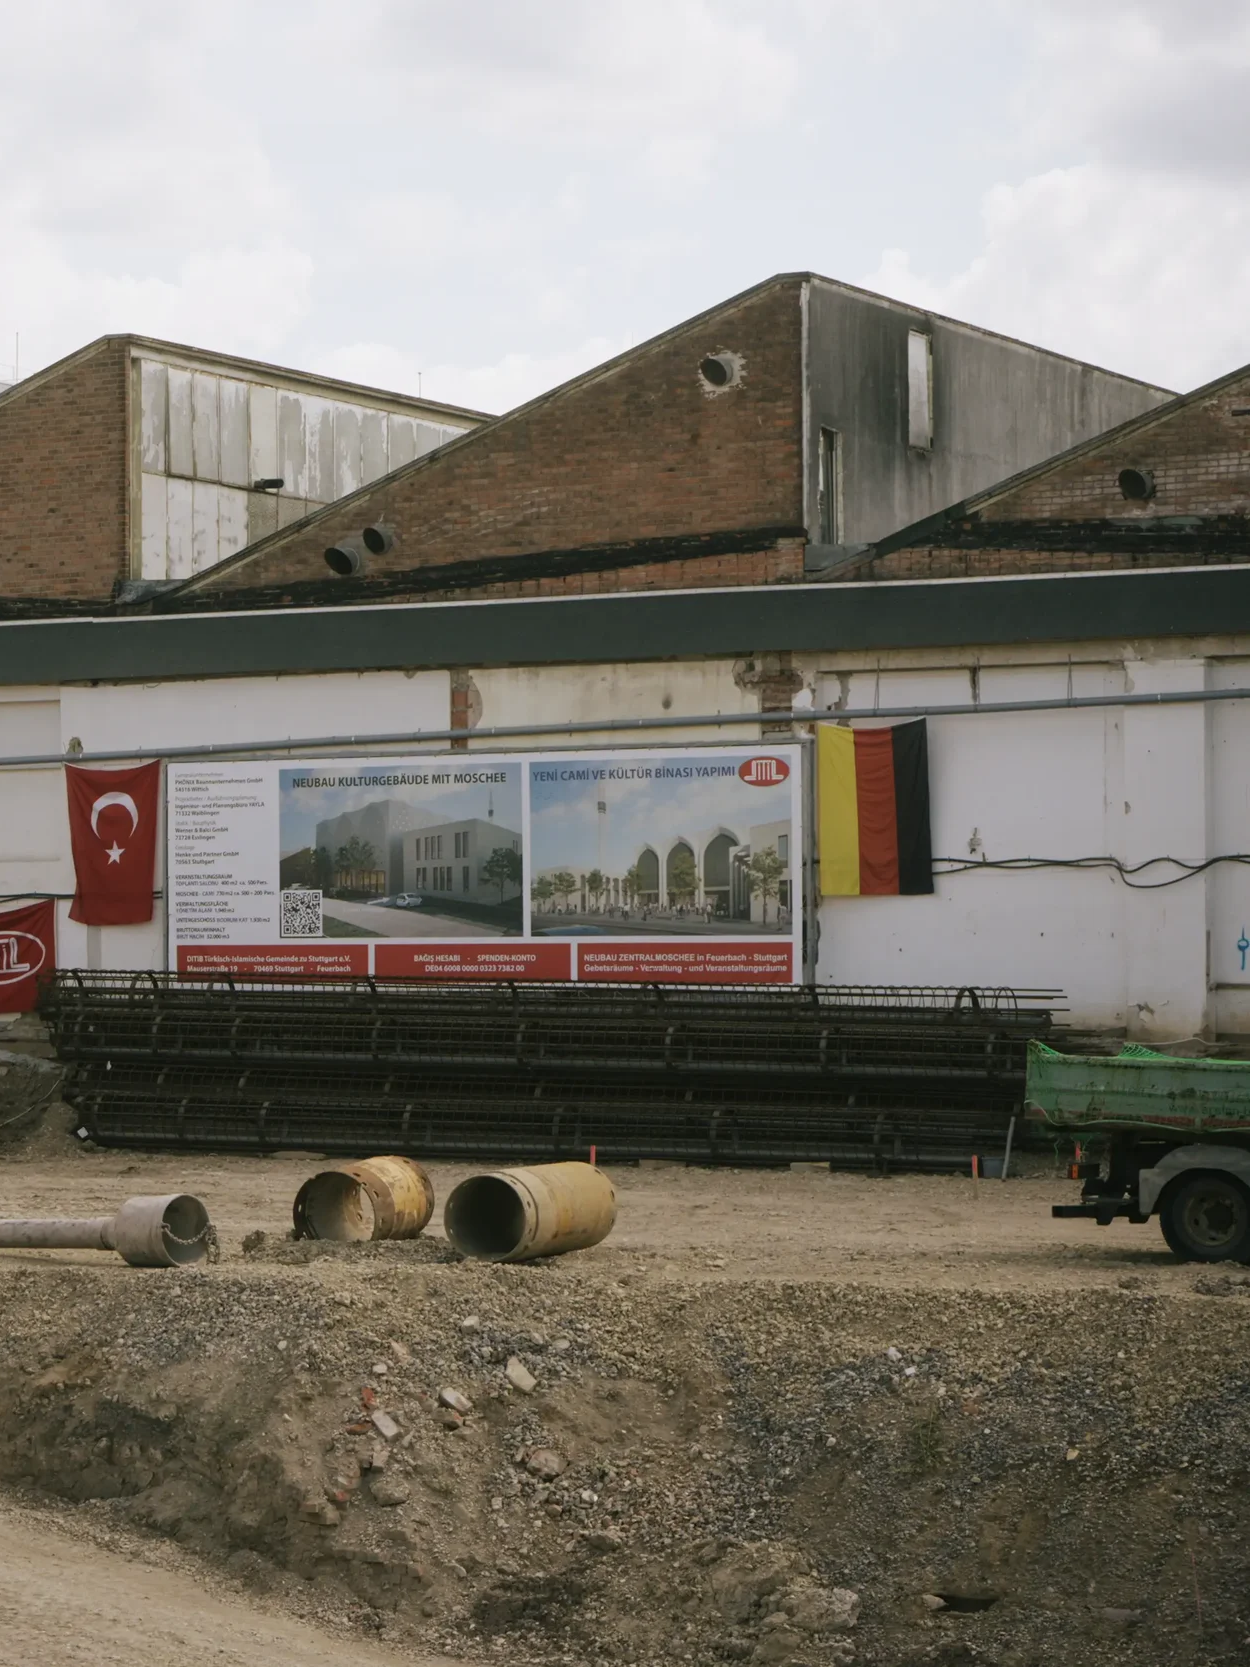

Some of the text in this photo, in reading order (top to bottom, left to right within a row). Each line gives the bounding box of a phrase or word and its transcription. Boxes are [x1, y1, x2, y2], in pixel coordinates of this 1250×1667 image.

[532, 769, 558, 782] YENİ
[560, 768, 589, 781] CAMİ
[591, 769, 606, 780] VE
[609, 767, 652, 779] KÜLTÜR
[655, 766, 693, 779] BİNASI
[695, 766, 735, 778] YAPIMI
[292, 772, 506, 788] NEUBAU KULTURGEBÄUDE MIT MOSCHEE
[204, 955, 265, 963] Türkisch-Islamische
[265, 955, 299, 963] Gemeinde
[308, 955, 338, 964] Stuttgart
[413, 953, 435, 963] BAĞIŞ
[435, 954, 461, 962] HESABI
[477, 954, 537, 962] SPENDEN-KONTO
[584, 953, 617, 962] NEUBAU
[618, 953, 695, 962] ZENTRALMOSCHEE
[696, 953, 705, 961] in
[706, 953, 747, 962] Feuerbach
[753, 953, 787, 963] Stuttgart
[274, 965, 304, 973] Stuttgart
[584, 964, 634, 972] Gebetsräume
[640, 964, 683, 973] Verwaltung
[688, 964, 704, 972] und
[705, 964, 787, 973] Veranstaltungsräume
